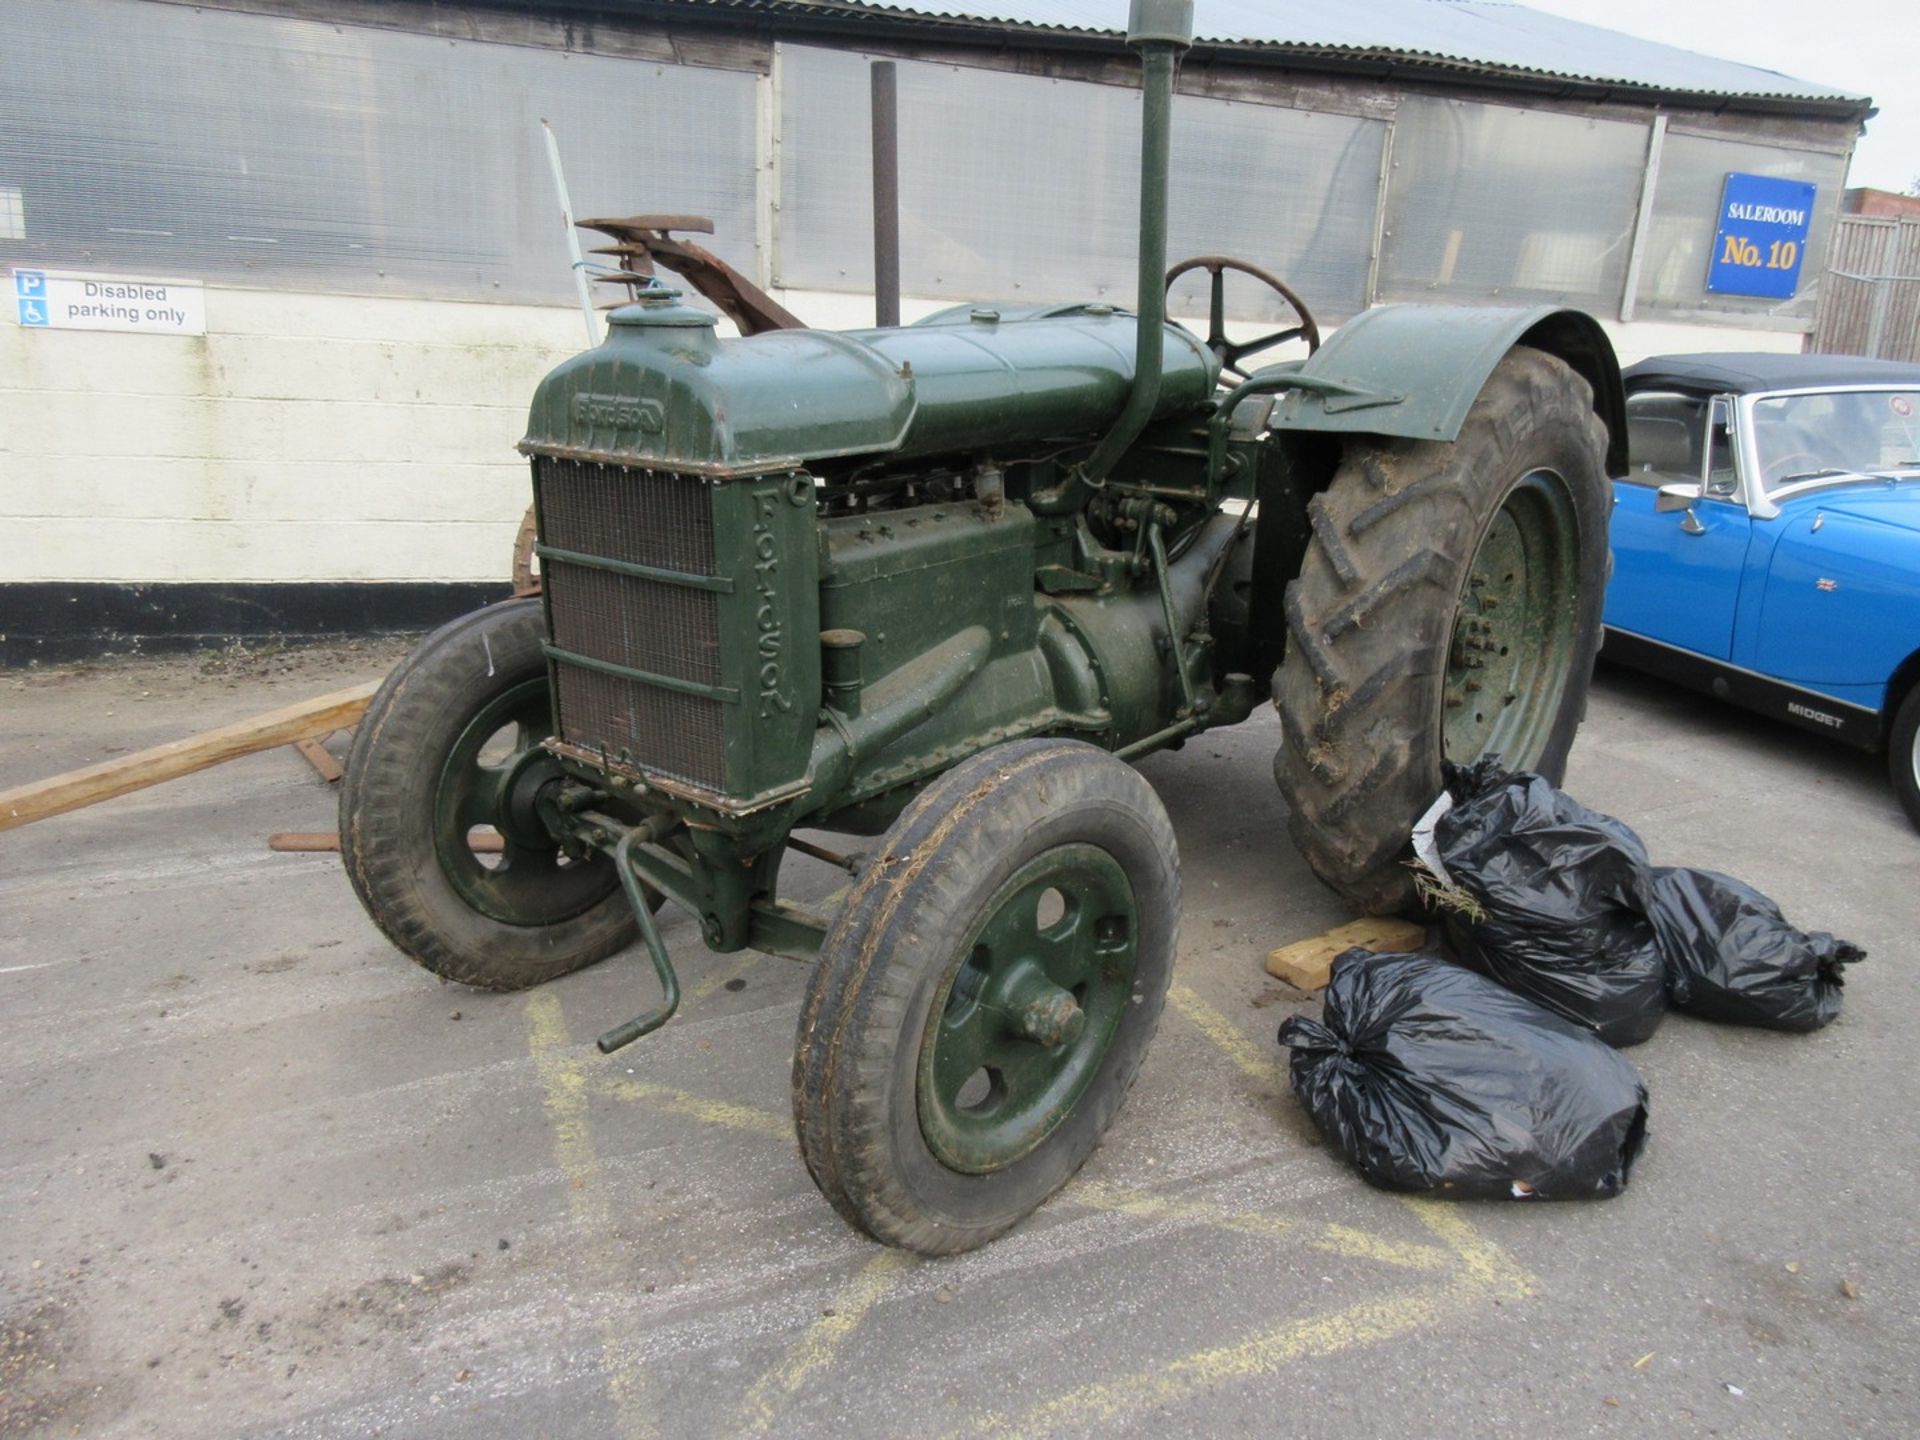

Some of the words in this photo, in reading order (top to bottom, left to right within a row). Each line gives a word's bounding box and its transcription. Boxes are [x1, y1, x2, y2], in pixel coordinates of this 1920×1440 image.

[1728, 202, 1804, 226] SALEROOM
[1721, 236, 1762, 267] No.
[1766, 240, 1796, 270] 10
[22, 276, 40, 294] P
[84, 282, 167, 301] Disabled
[68, 303, 140, 323] parking
[146, 308, 186, 326] only
[1787, 702, 1844, 729] MIDGET
